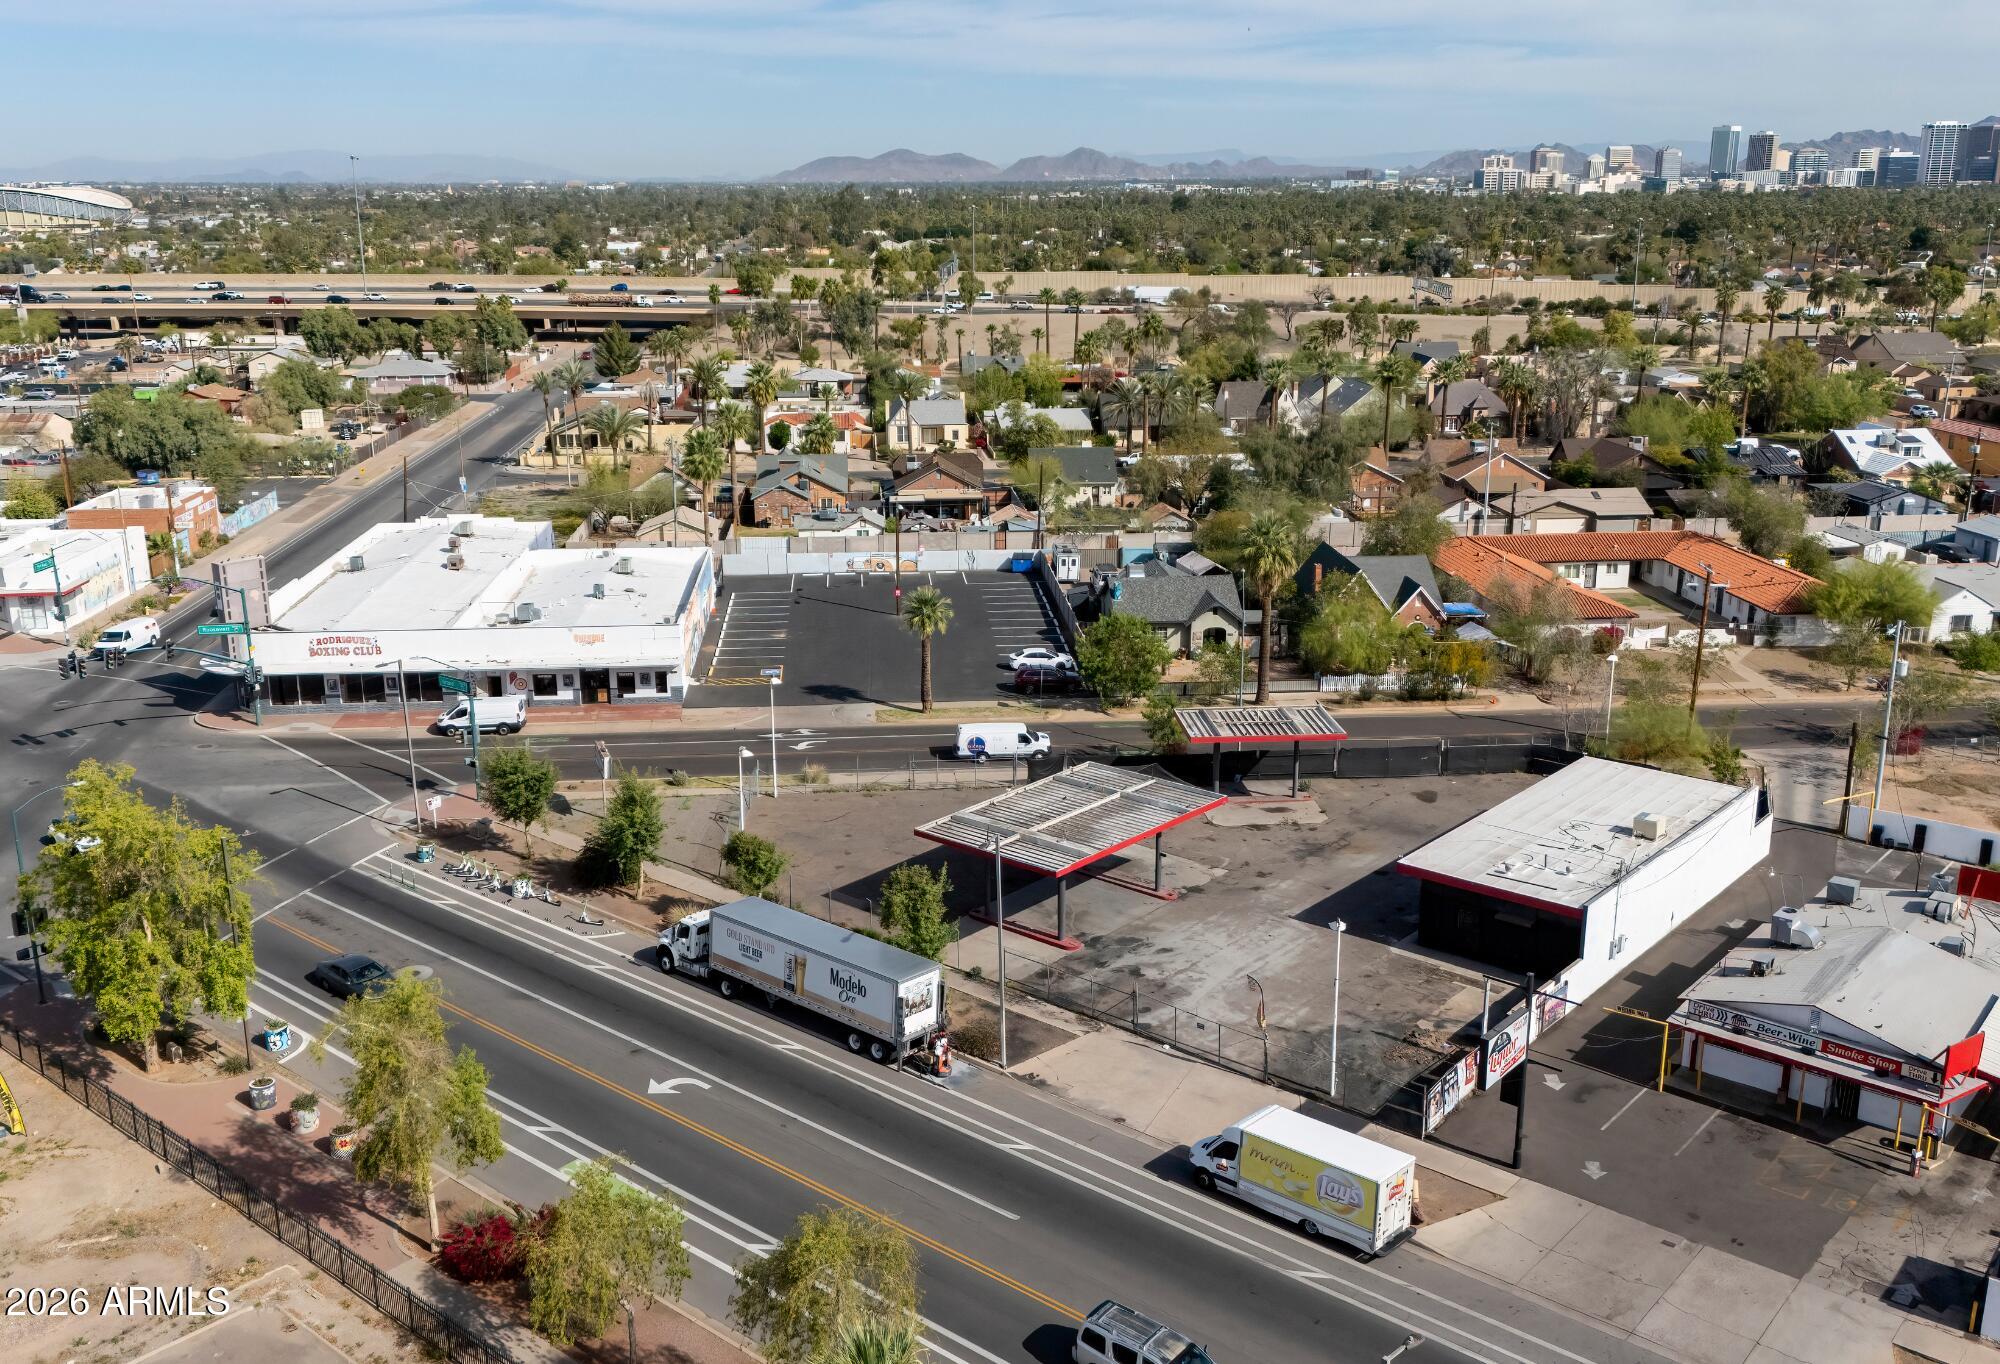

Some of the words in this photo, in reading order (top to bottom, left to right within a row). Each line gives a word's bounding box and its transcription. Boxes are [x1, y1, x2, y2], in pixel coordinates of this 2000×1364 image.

[309, 647, 351, 657] BOXING
[353, 646, 382, 656] CLUB
[316, 636, 372, 646] RODRIGUEZ
[726, 927, 742, 941] GOLD
[744, 934, 776, 955] STANDARD
[738, 943, 751, 955] LIGHT
[751, 947, 763, 959] BEER
[829, 967, 867, 998] Modelo
[838, 989, 857, 1004] Oro
[1826, 1043, 1864, 1061] Smoke
[1866, 1055, 1897, 1072] Shop
[1317, 1175, 1363, 1204] Lay's
